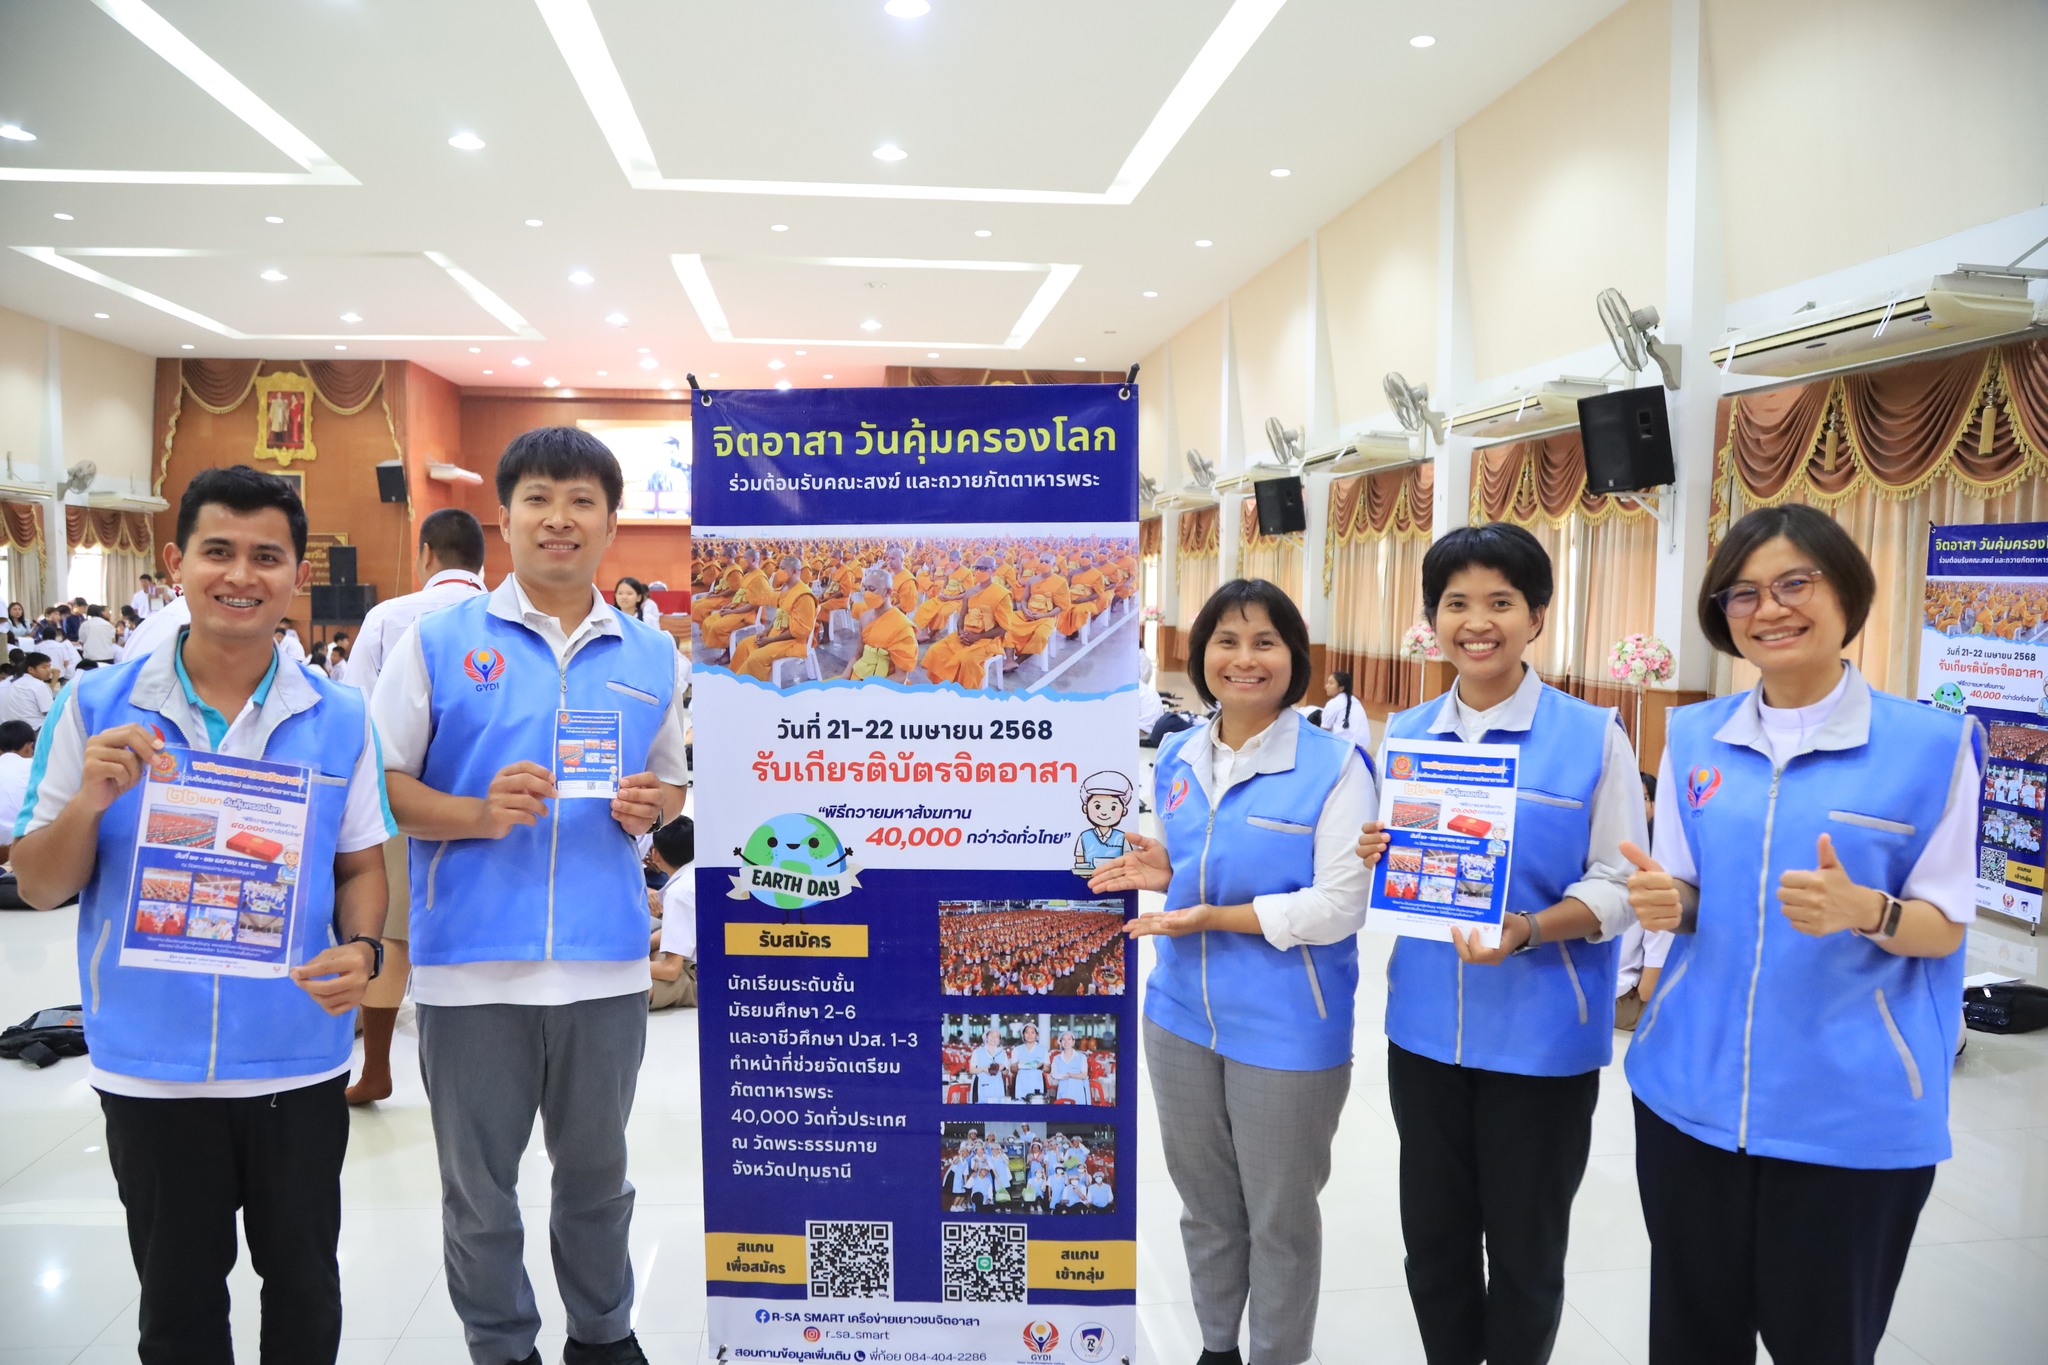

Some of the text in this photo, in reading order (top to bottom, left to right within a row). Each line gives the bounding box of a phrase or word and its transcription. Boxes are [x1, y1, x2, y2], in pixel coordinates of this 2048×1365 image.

[713, 416, 1117, 464] จิตอาสา วันคุ้มครองโลก
[729, 469, 1101, 492] ร่วมต้อนรับคณะสงฆ์ และถวายภัตตาหารพระ
[1935, 538, 1976, 551] จิตอาสา
[1947, 646, 2037, 662] วันที่ 21-22 เมษายน 2568
[1938, 658, 2044, 679] รับเกียรติบัตรจิตอาสา
[476, 682, 500, 693] GYDI
[1970, 690, 2001, 700] 40,000
[777, 712, 1053, 741] วันที่ 21-22 เมษายน 2568
[751, 748, 1079, 784] รับเกียรติบัตรจิตอาสา
[818, 804, 973, 821] “พิธีถวายมหาสังฆทาน
[866, 825, 1072, 851] 40,000 กว่าวัดทั่วไทย”
[752, 868, 840, 898] EARTH DAY
[759, 930, 831, 949] รับสมัคร
[728, 972, 855, 993] นักเรียนระดับชั้น
[728, 1002, 856, 1019] มัธยมศึกษา 2-6
[729, 1029, 918, 1048] และอาชีวศึกษา ปวส. 1-3
[730, 1051, 900, 1074] ทำหน้าที่ช่วยจัดเตรียม
[730, 1082, 833, 1099] ภัตตาหารพระ
[731, 1106, 906, 1128] 40,000 วัดทั่วประเทศ
[732, 1135, 877, 1153] ณ วัดพระธรรมกาย
[732, 1160, 852, 1182] จังหวัดปทุมธานี
[737, 1242, 774, 1253] สแกน
[1061, 1249, 1099, 1260] สแกน
[726, 1256, 786, 1274] เพื่อสมัคร
[1055, 1268, 1105, 1284] เข้ากลุ่ม
[772, 1312, 980, 1327] R-SA SMART เครือข่ายเยาวชนจิตอาสา
[826, 1330, 890, 1341] r_sa_smart
[735, 1346, 987, 1364] สอบถามข้อมูลเพิ่มเติม พี่ก้อย 084-404-2286
